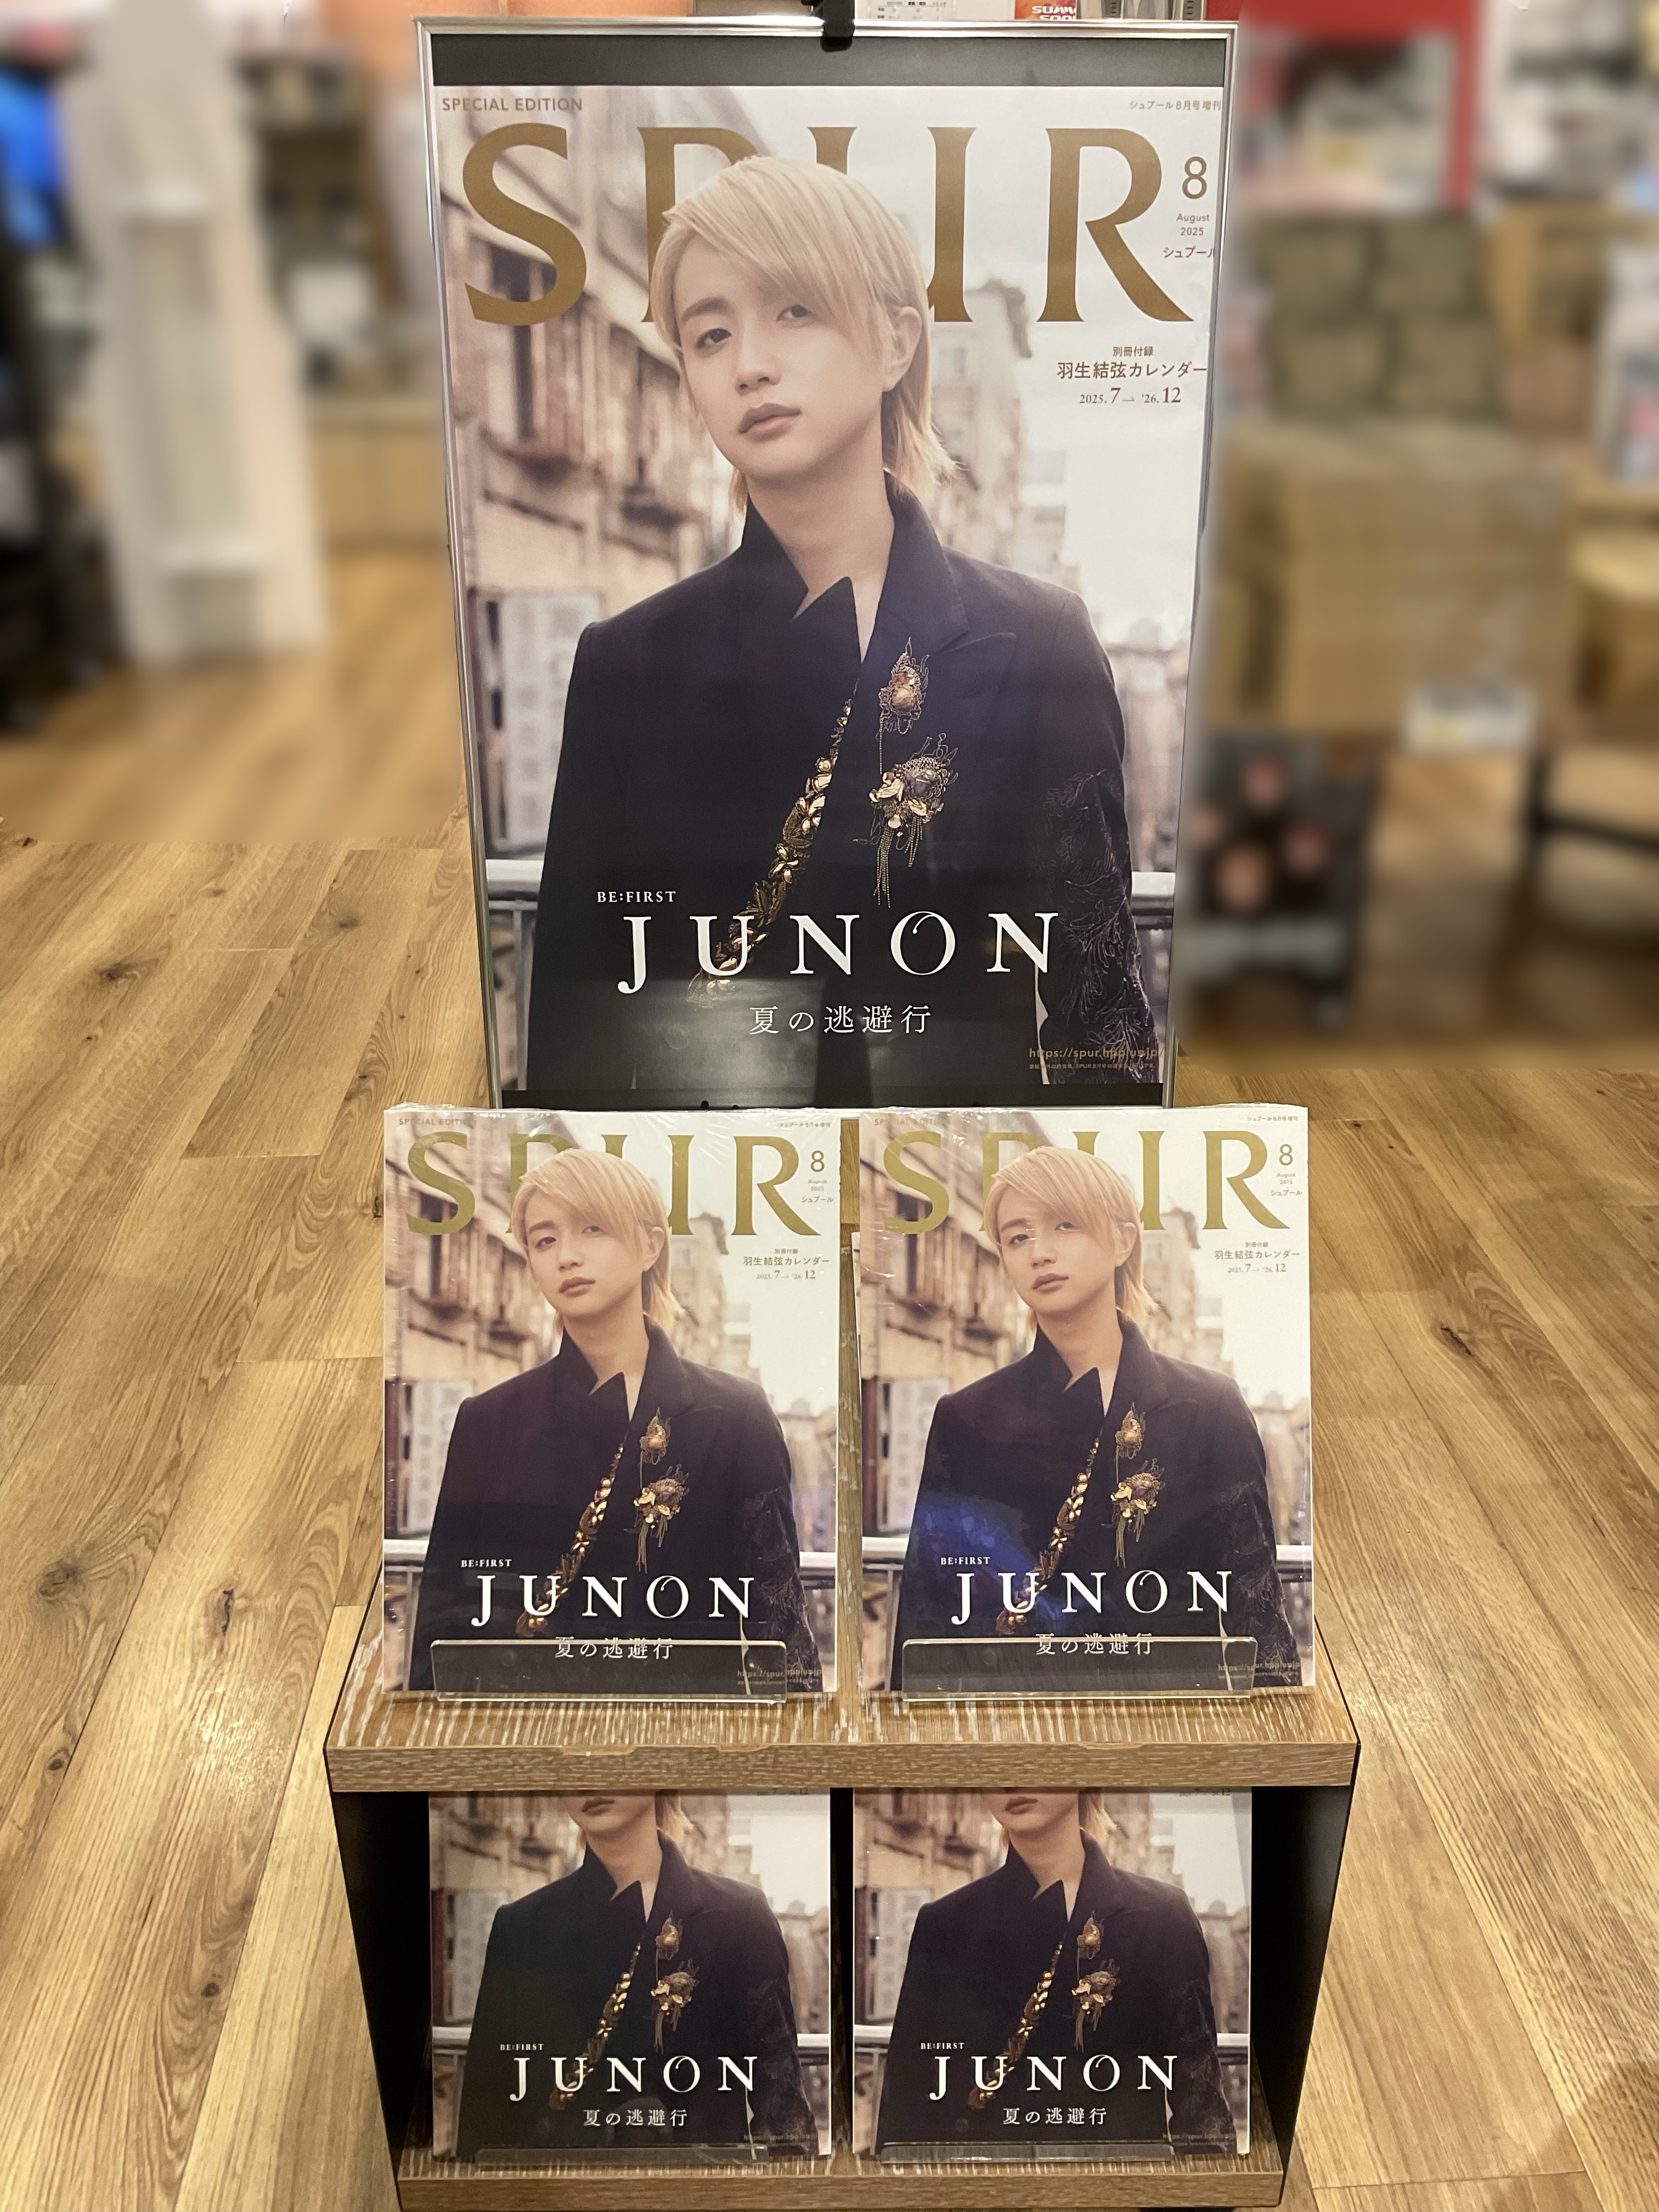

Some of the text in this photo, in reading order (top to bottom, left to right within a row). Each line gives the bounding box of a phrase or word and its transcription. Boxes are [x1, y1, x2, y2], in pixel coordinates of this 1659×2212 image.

[442, 98, 582, 111] SPECIAL EDITION
[1182, 156, 1207, 199] 8
[1176, 213, 1210, 224] August
[1180, 227, 1204, 236] 2025
[1112, 346, 1154, 357] 別冊付録
[1057, 360, 1207, 380] 羽生結弦カレンダー
[597, 891, 676, 902] BE:FIRST
[618, 911, 1059, 994] JUNON
[749, 1005, 932, 1035] 夏の逃避行
[810, 1150, 825, 1172] 8
[1279, 1144, 1293, 1166] 8
[743, 1256, 830, 1266] 羽生結弦カレンダー
[1214, 1250, 1300, 1260] 羽生結弦カレンダー
[461, 1559, 512, 1568] BE:FIRST
[940, 1556, 991, 1565] BE:FIRST
[471, 1575, 755, 1628] JUNON
[951, 1570, 1233, 1625] JUNON
[555, 1636, 673, 1660] 夏の逃避行
[1035, 1633, 1153, 1655] 夏の逃避行
[510, 2056, 758, 2102] JUNON
[929, 2054, 1178, 2101] JUNON
[583, 2109, 687, 2127] 夏の逃避行
[1003, 2107, 1107, 2125] 夏の逃避行
